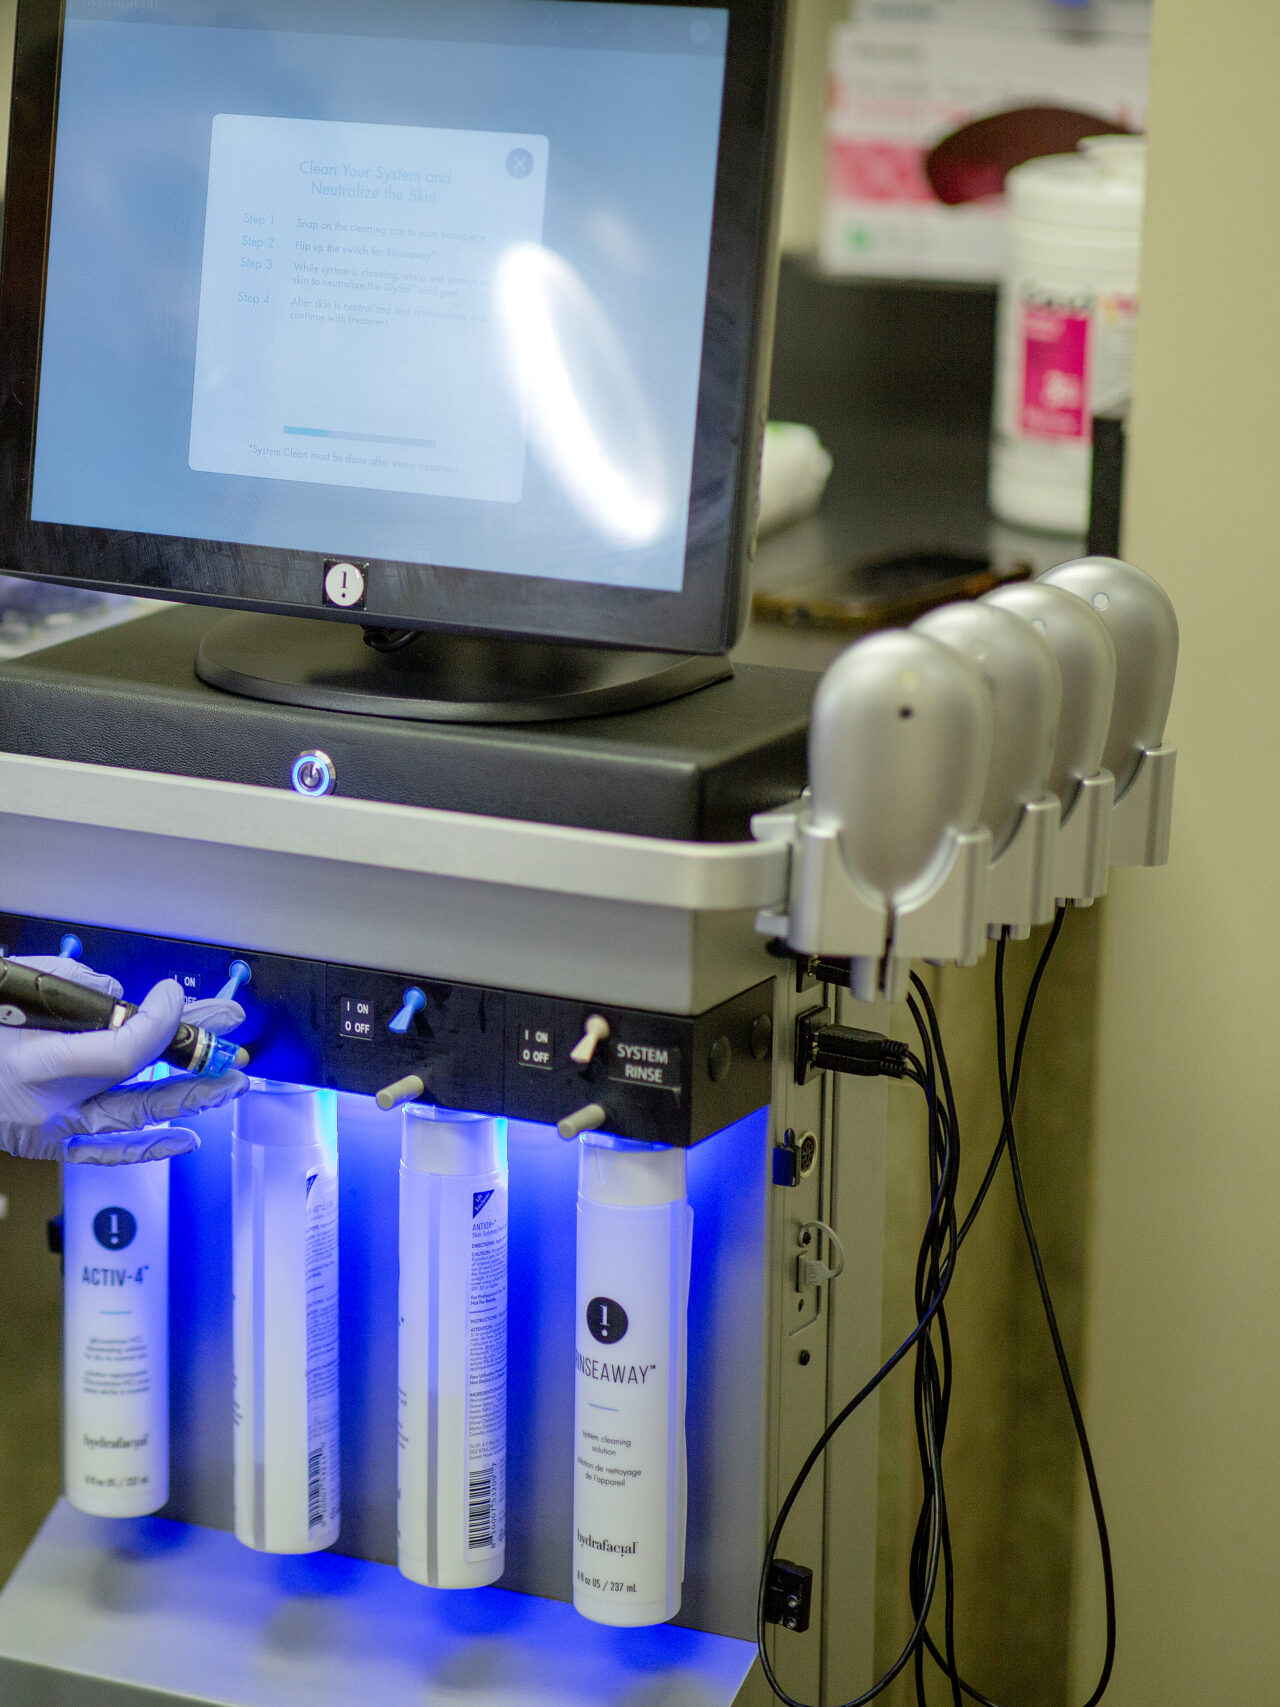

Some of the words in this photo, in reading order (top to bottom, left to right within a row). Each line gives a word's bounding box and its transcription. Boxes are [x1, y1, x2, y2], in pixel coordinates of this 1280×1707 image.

[299, 161, 336, 177] Clean
[342, 164, 370, 178] Your
[375, 166, 421, 184] System
[425, 169, 452, 184] and
[311, 182, 379, 199] Neutralize
[384, 185, 404, 200] the
[409, 188, 437, 203] Skin
[243, 214, 265, 226] Step
[270, 215, 275, 225] 1
[297, 218, 318, 232] Snap
[321, 222, 332, 230] on
[335, 221, 347, 231] the
[350, 224, 386, 237] cleaning
[407, 227, 415, 236] to
[418, 230, 438, 240] your
[242, 236, 264, 249] Step
[267, 237, 274, 248] 2
[295, 240, 311, 252] Flip
[313, 243, 324, 254] up
[327, 244, 340, 254] the
[342, 245, 368, 256] switch
[371, 246, 384, 256] for
[240, 257, 264, 271] Step
[266, 259, 272, 269] 3
[293, 262, 319, 273] While
[321, 265, 348, 278] system
[353, 268, 358, 276] is
[293, 274, 309, 285] skin
[311, 277, 320, 286] to
[323, 278, 364, 290] neutralize
[368, 281, 380, 291] the
[237, 292, 262, 305] Step
[264, 294, 270, 305] 4
[291, 297, 312, 308] After
[315, 299, 331, 310] skin
[334, 302, 340, 311] is
[344, 302, 390, 314] neutralized
[394, 305, 410, 316] and
[289, 311, 325, 322] continue
[327, 314, 345, 324] with
[284, 448, 308, 459] Clean
[311, 451, 330, 461] must
[333, 452, 343, 462] be
[345, 453, 366, 464] done
[369, 455, 388, 467] after
[392, 460, 415, 472] every
[184, 976, 196, 987] ON
[357, 1003, 369, 1014] ON
[354, 1022, 370, 1034] OFF
[535, 1031, 548, 1044] ON
[533, 1051, 549, 1064] OFF
[616, 1042, 669, 1064] SYSTEM
[624, 1063, 663, 1083] RINSE
[601, 1435, 632, 1448] cleaning
[592, 1445, 616, 1456] solution
[585, 1471, 592, 1480] de
[595, 1464, 604, 1472] de
[605, 1468, 642, 1478] nettoyage
[592, 1576, 601, 1588] US
[602, 1580, 608, 1591] /
[610, 1582, 624, 1592] 237
[627, 1584, 638, 1593] mL
